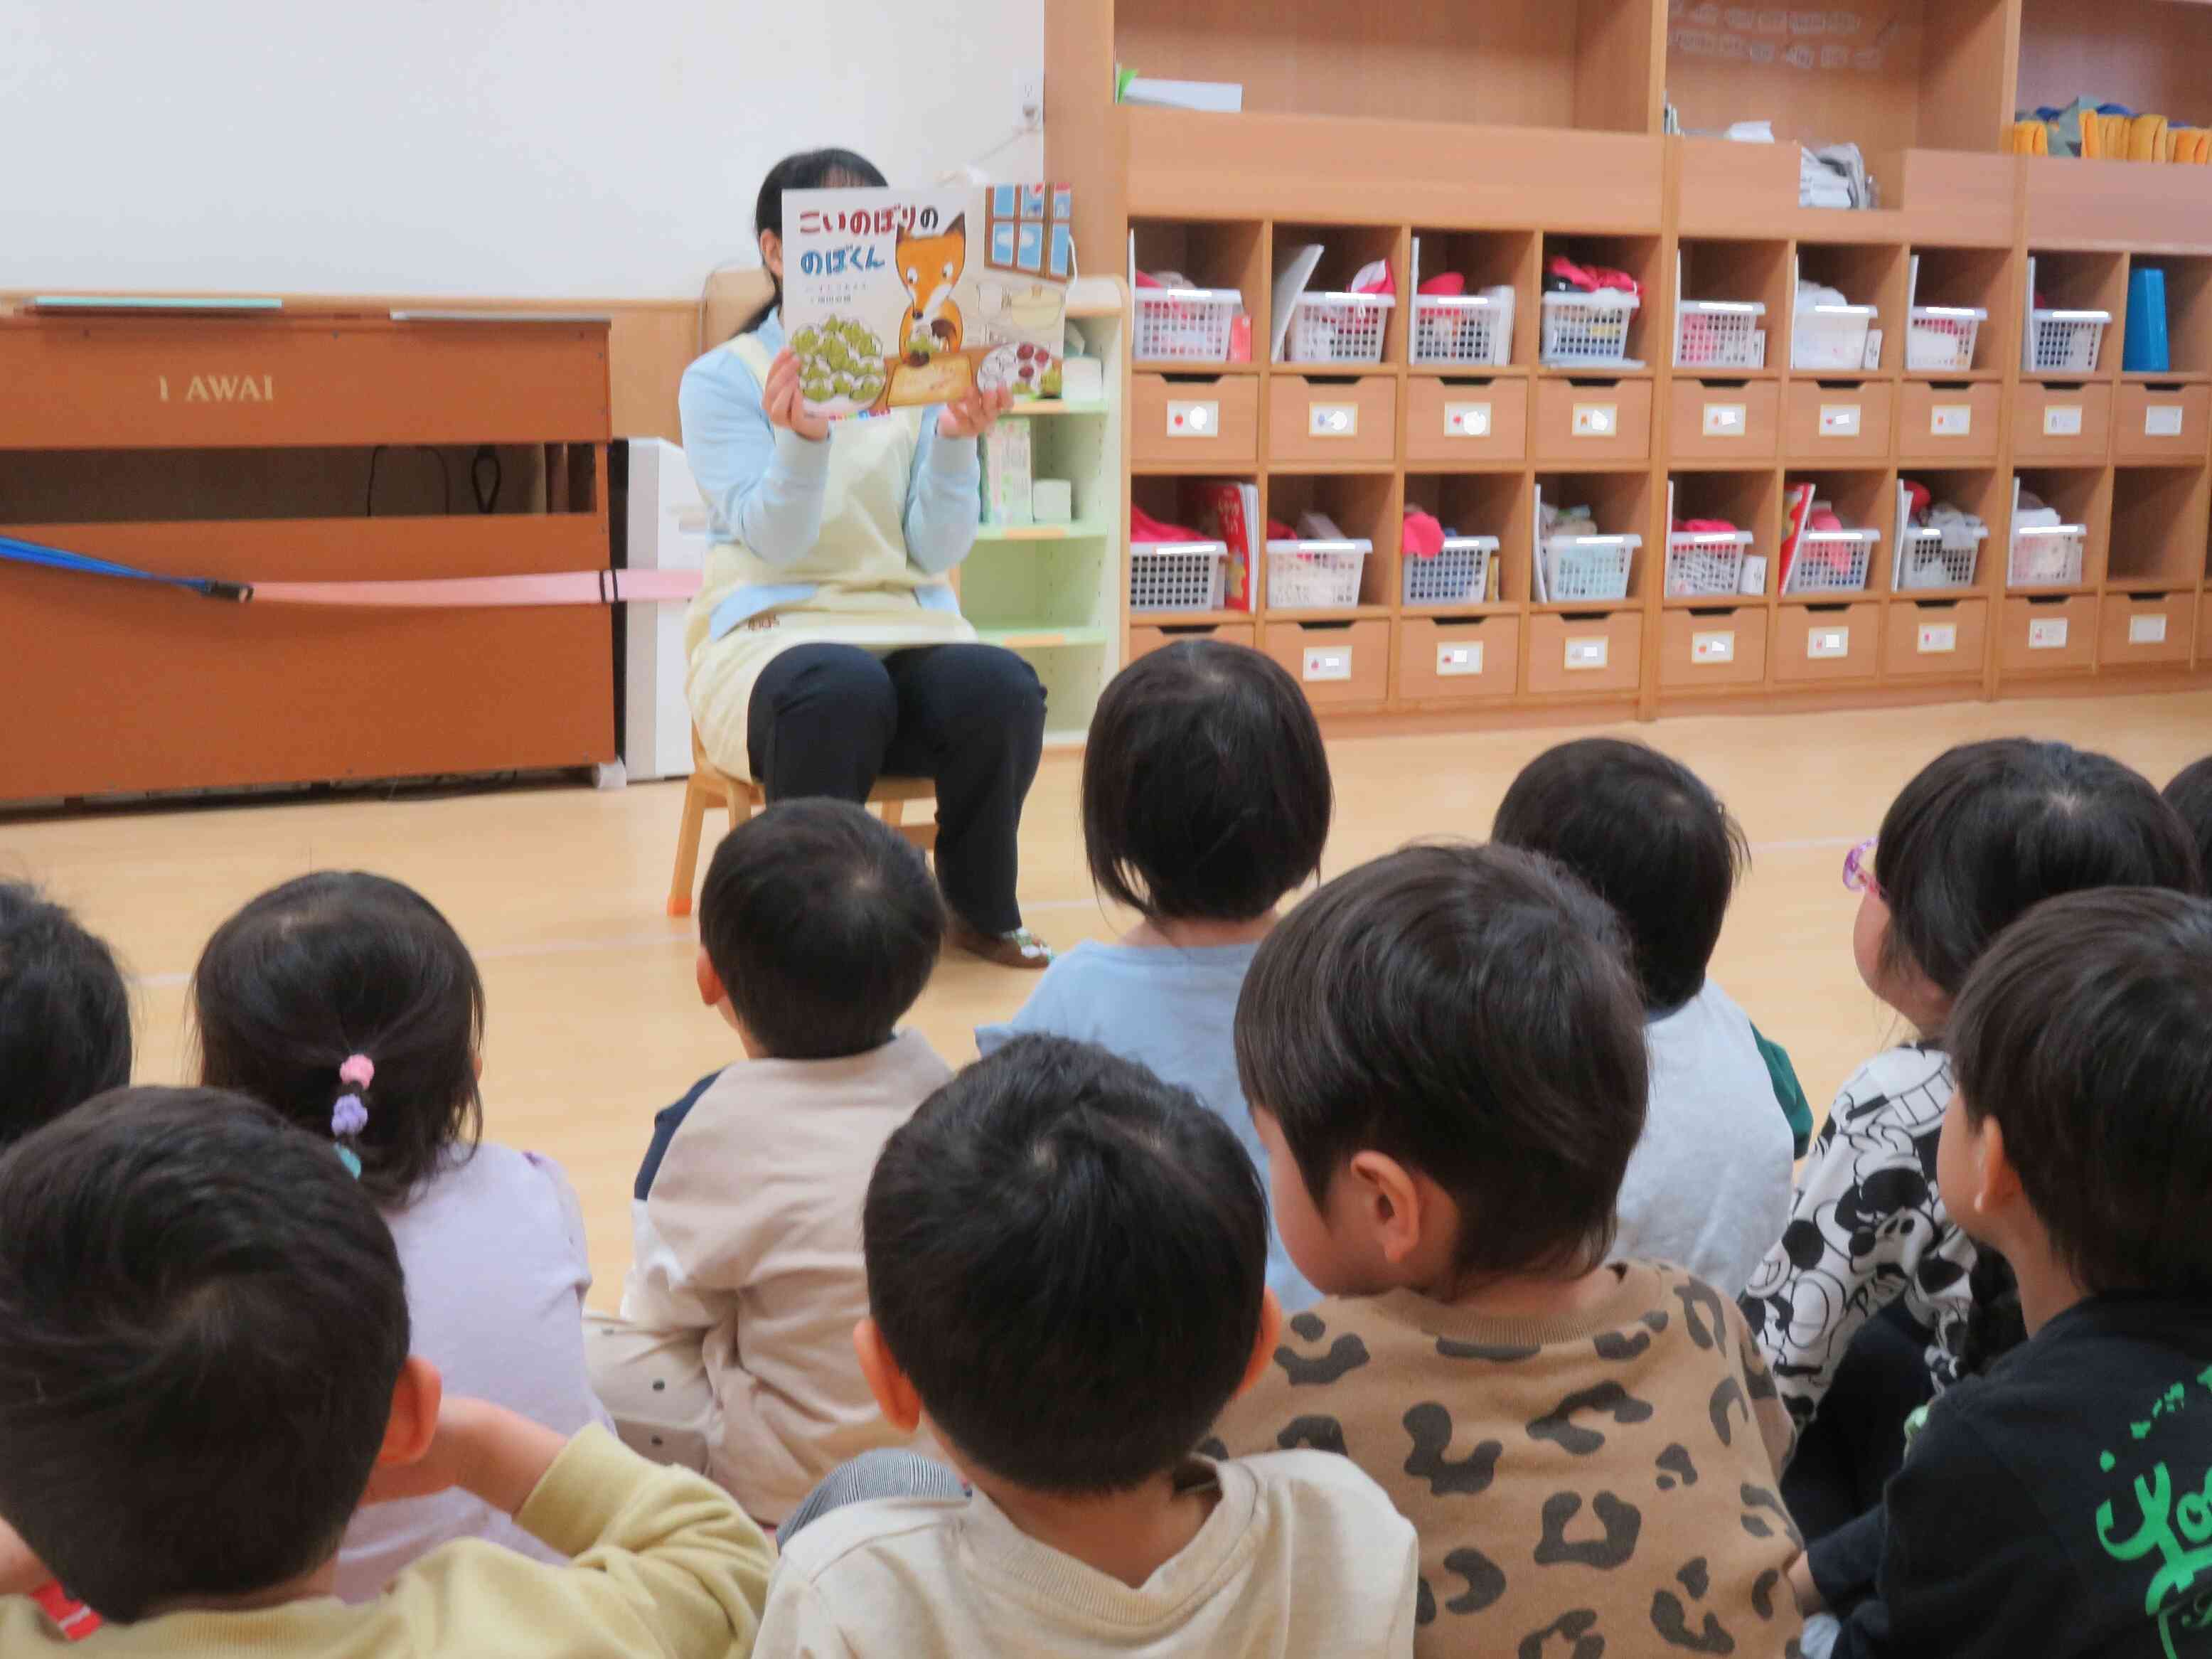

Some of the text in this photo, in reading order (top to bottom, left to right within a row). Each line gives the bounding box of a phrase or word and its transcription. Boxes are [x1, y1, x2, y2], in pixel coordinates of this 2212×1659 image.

[799, 204, 939, 235] こいのぼりの
[801, 245, 885, 275] のぼくん
